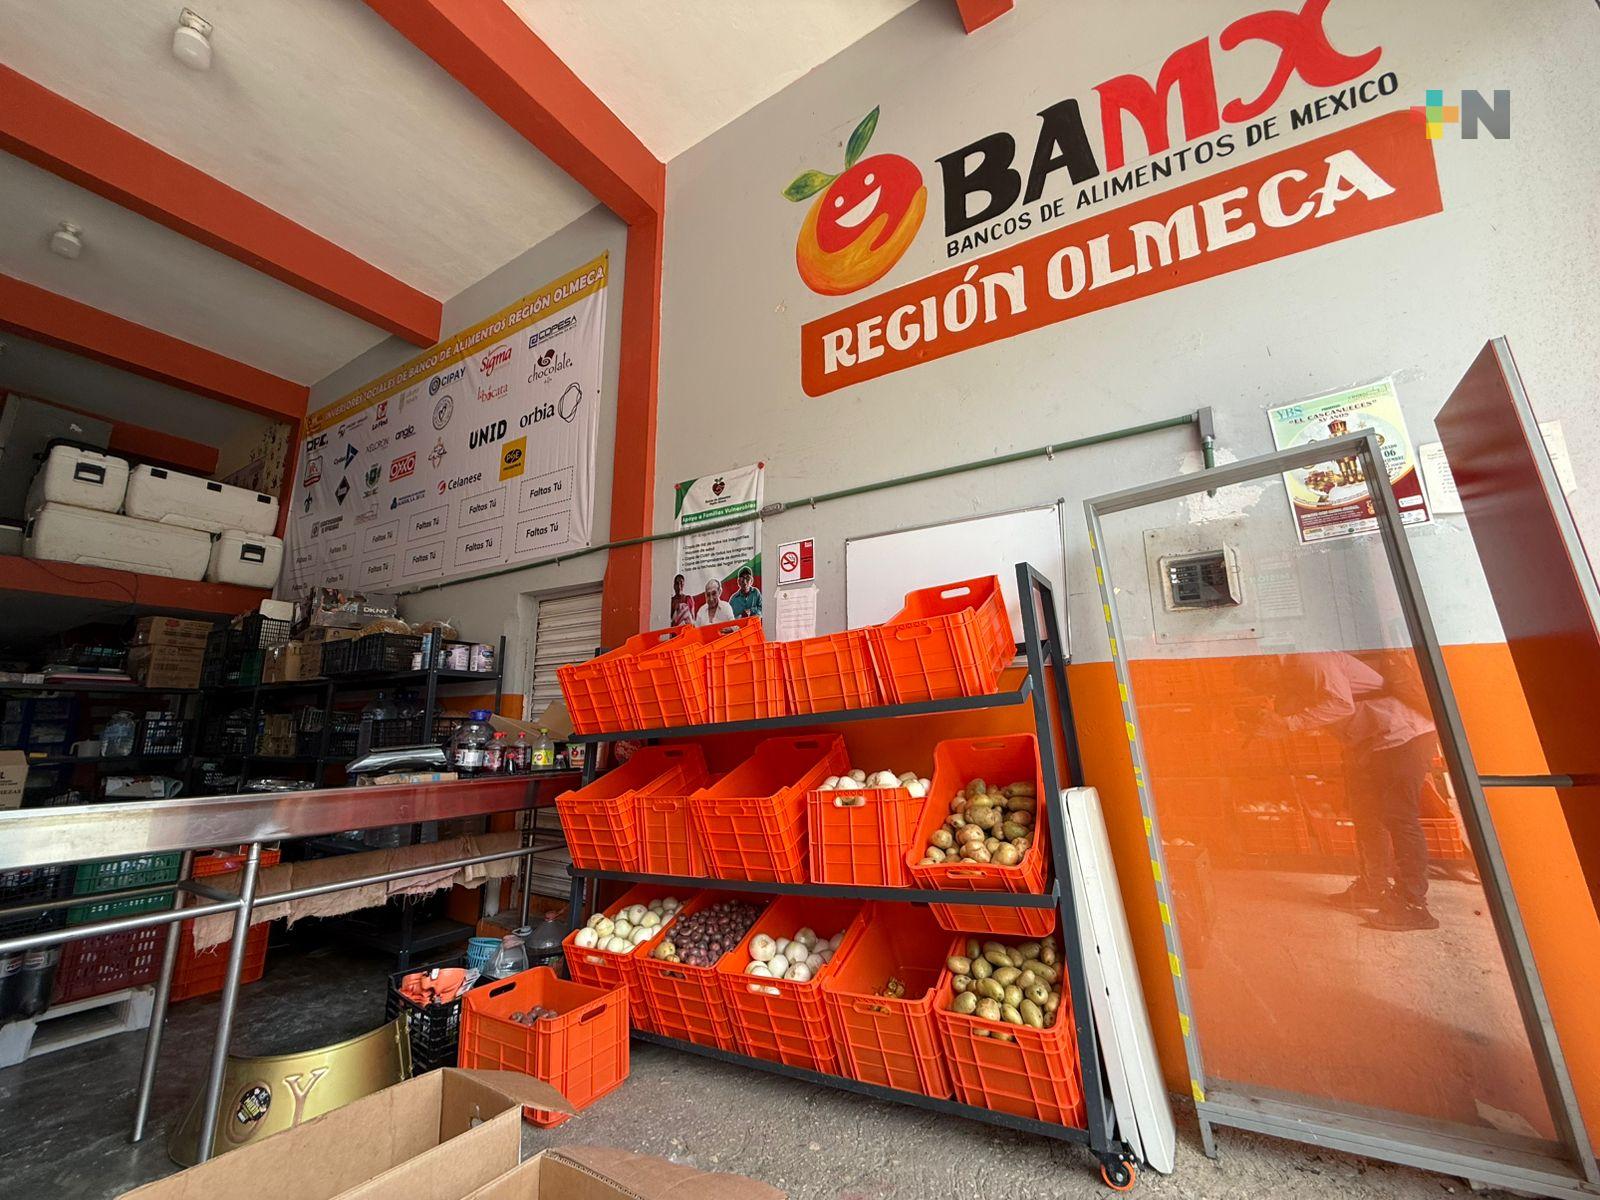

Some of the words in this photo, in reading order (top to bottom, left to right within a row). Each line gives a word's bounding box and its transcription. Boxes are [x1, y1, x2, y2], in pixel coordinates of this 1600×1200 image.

[934, 0, 1382, 237] BAMX
[946, 213, 1031, 257] BANCOS
[1040, 198, 1064, 221] DE
[1077, 134, 1234, 210] ALIMENTOS
[1246, 117, 1279, 146] DE
[1291, 71, 1399, 130] MEXICO
[822, 264, 1026, 374] REGIÓN
[1048, 150, 1396, 300] OLMECA
[407, 355, 437, 378] BANCO
[440, 347, 450, 359] DE
[453, 319, 506, 354] ALIMENTOS
[508, 295, 550, 328] REGIÓN
[554, 266, 604, 302] OLMECA
[539, 315, 577, 339] COPESA
[480, 347, 512, 376] Sigma
[442, 366, 466, 386] CIPAY
[520, 403, 555, 428] orbia
[1276, 406, 1302, 420] YBS
[395, 425, 414, 440] anglo
[469, 420, 508, 449] UNID
[390, 456, 416, 477] OXXO
[448, 472, 482, 490] Celanese
[530, 485, 552, 498] Faltas
[554, 482, 562, 490] Tú
[469, 503, 488, 514] Faltas
[489, 500, 496, 508] Tú
[703, 511, 723, 519] Familias
[725, 504, 756, 514] Vulnerables
[416, 519, 432, 530] Faltas
[526, 524, 548, 538] Faltas
[550, 522, 559, 532] Tú
[372, 534, 386, 543] Faltas
[465, 541, 484, 552] Faltas
[485, 538, 492, 548] Tú
[412, 554, 428, 564] Faltas
[368, 564, 381, 574] Faltas
